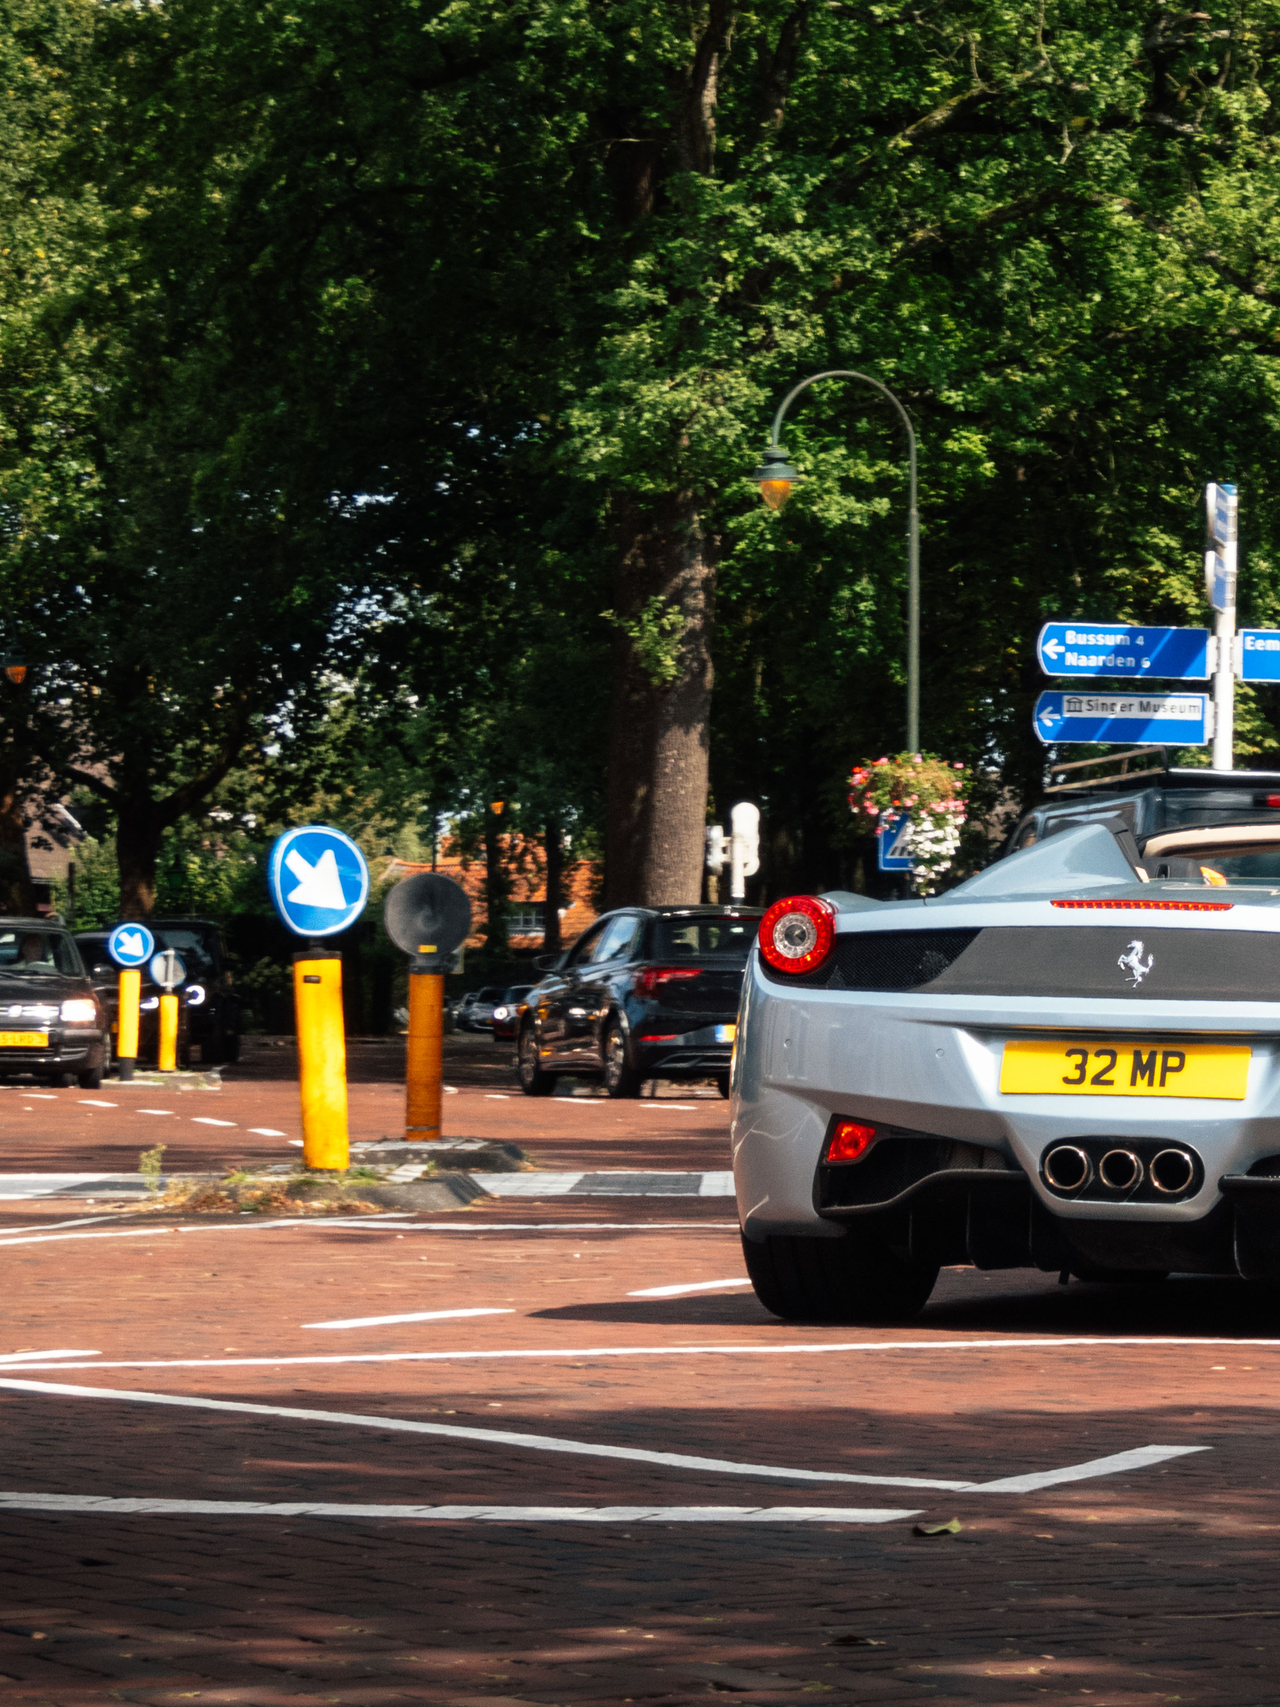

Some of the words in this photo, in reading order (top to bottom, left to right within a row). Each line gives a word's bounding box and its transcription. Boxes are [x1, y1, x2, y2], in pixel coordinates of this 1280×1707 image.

[1065, 630, 1130, 646] Bussum
[1135, 635, 1145, 646] 4
[1065, 652, 1136, 667] Naarden
[1086, 698, 1134, 714] Singer
[1139, 700, 1200, 714] Museum
[1062, 1048, 1118, 1086] 32
[1130, 1050, 1186, 1087] MP
